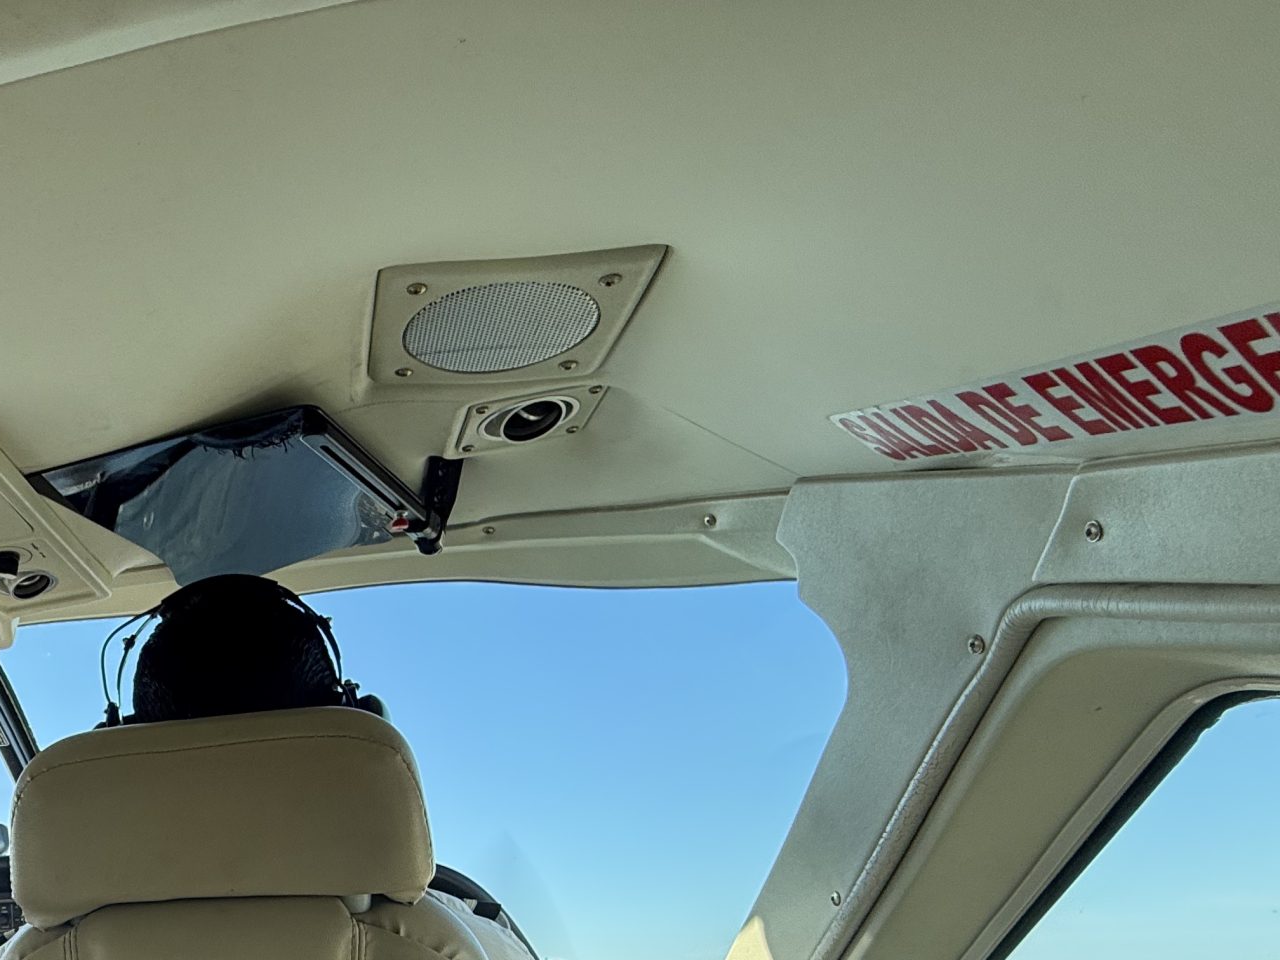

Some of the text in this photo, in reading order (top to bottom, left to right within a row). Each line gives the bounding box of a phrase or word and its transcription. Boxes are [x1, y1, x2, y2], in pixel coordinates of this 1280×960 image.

[838, 312, 1280, 461] SALIDA DE EMERGE
